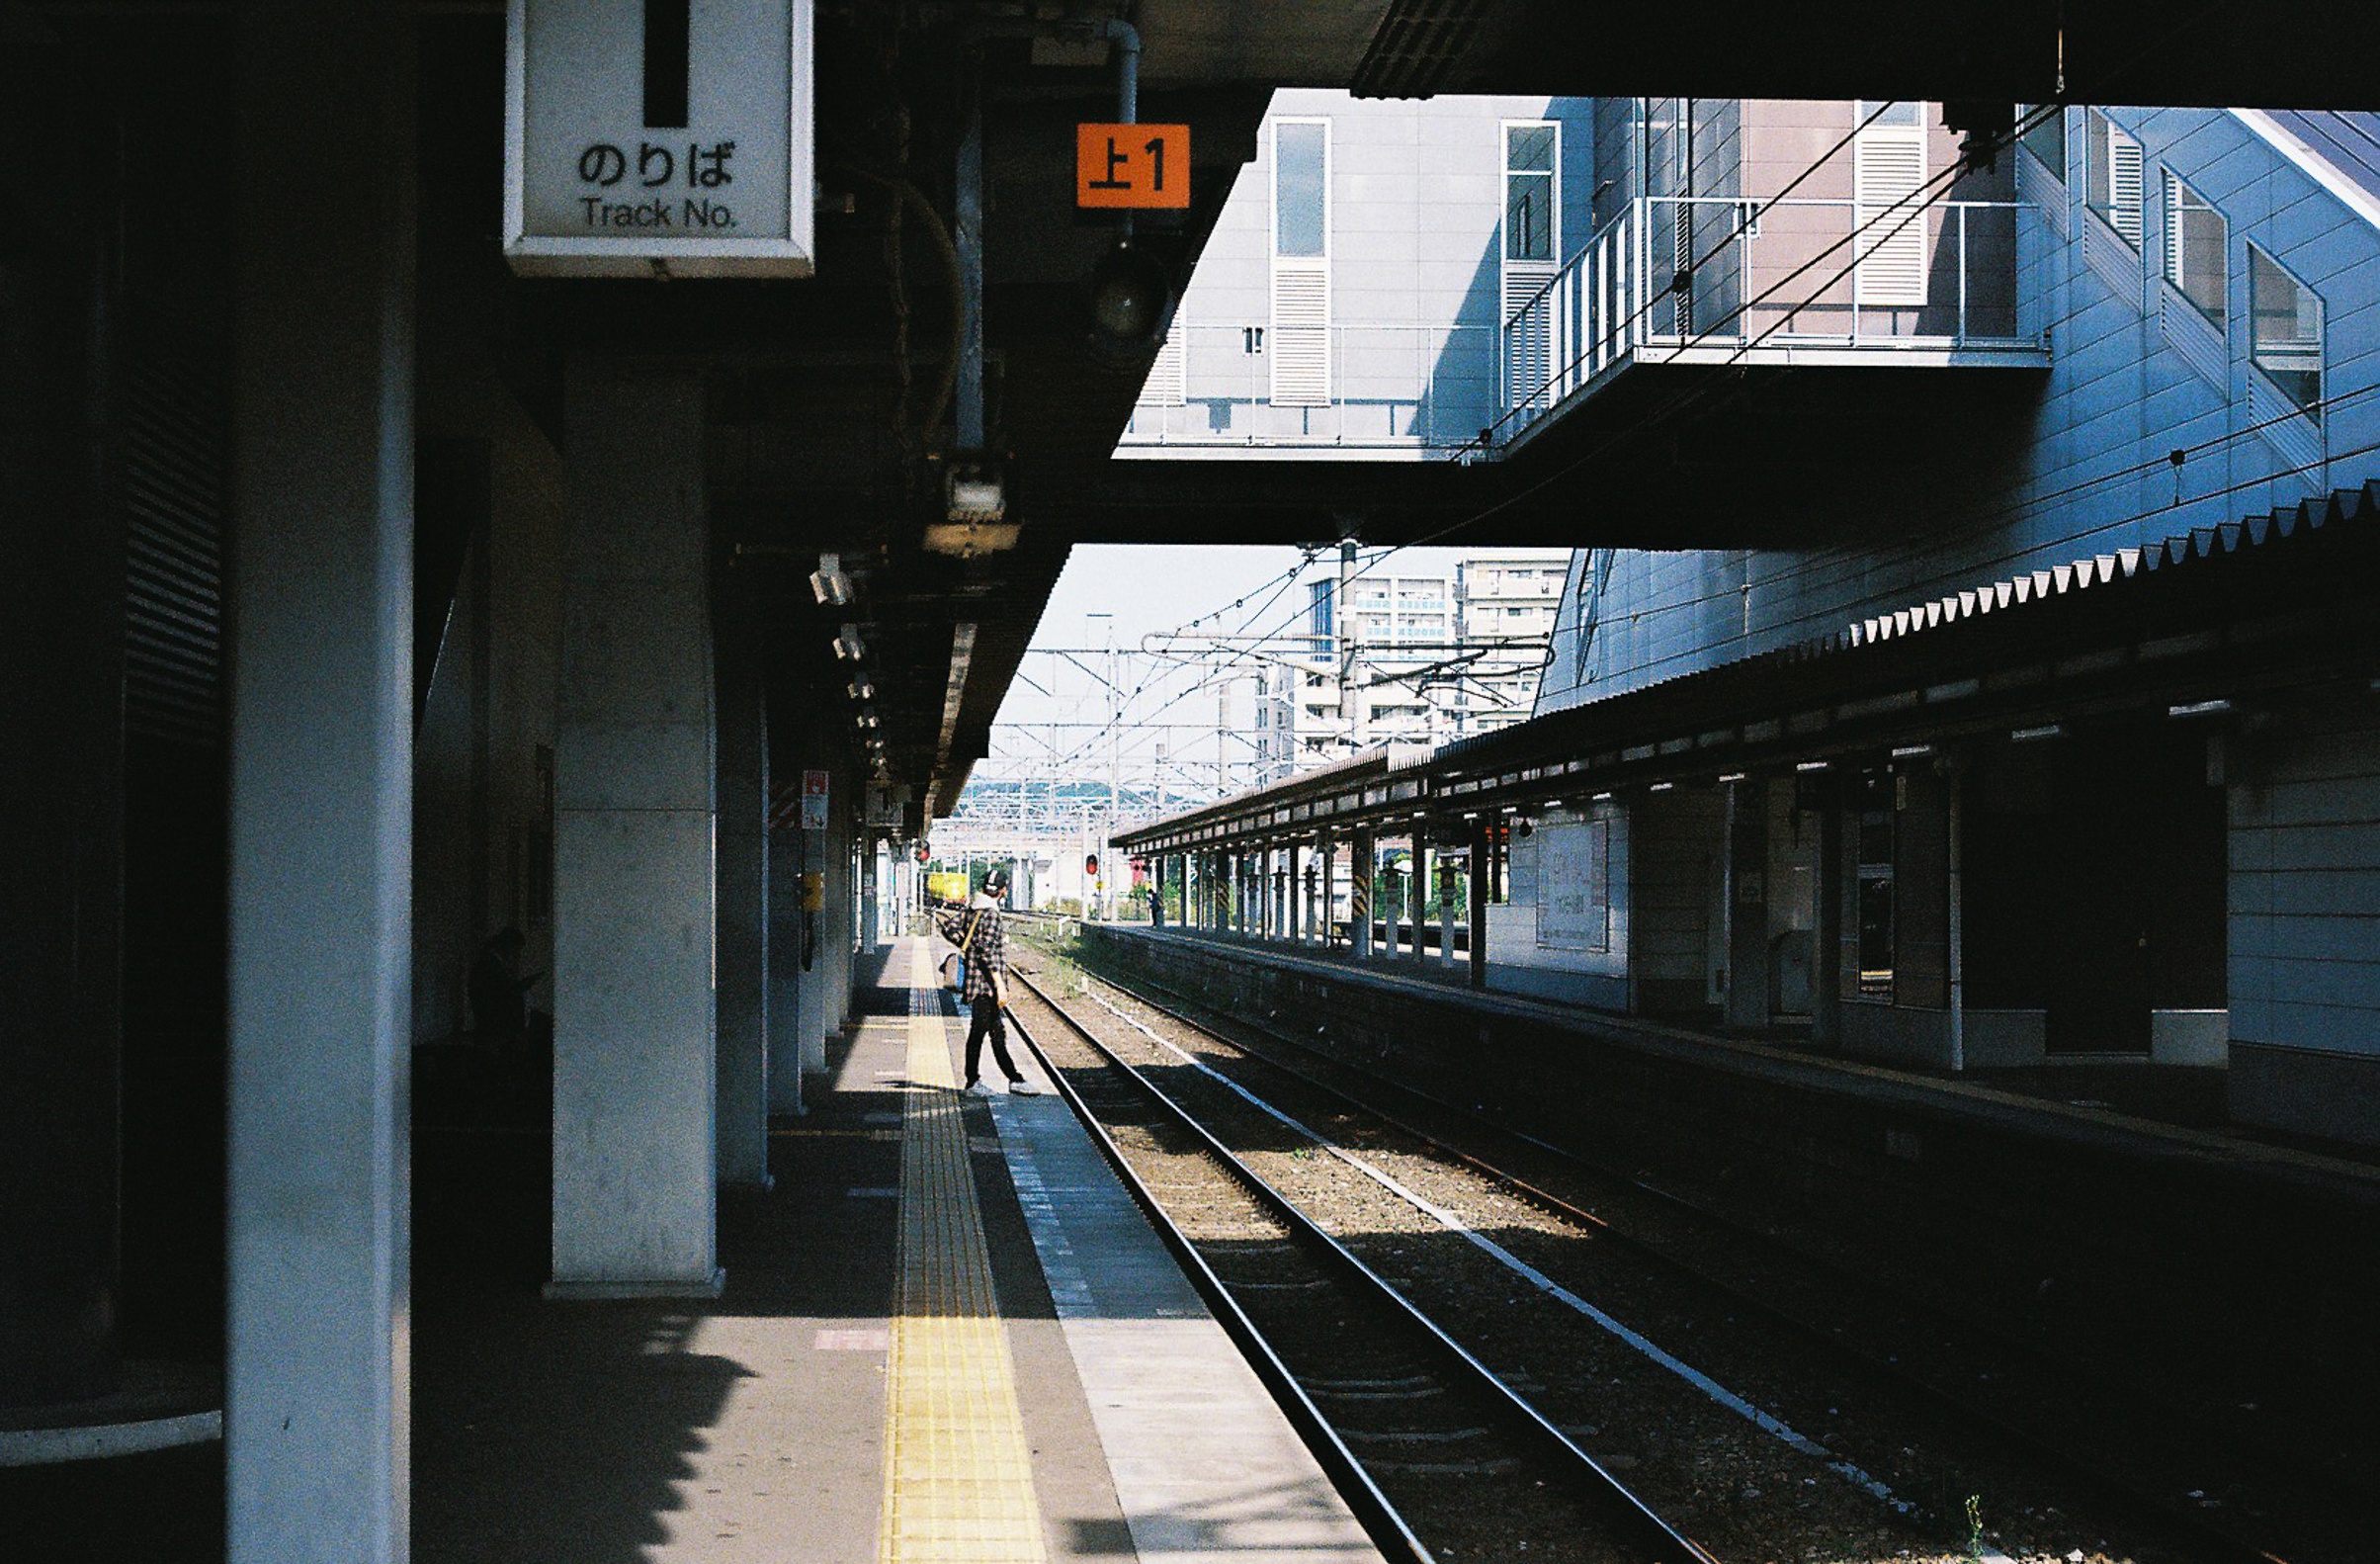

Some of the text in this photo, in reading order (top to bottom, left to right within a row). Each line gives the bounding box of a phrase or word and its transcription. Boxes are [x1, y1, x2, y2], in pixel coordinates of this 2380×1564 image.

[578, 140, 736, 188] のりば
[1088, 137, 1164, 192] 上1
[580, 197, 736, 228] Track No.
